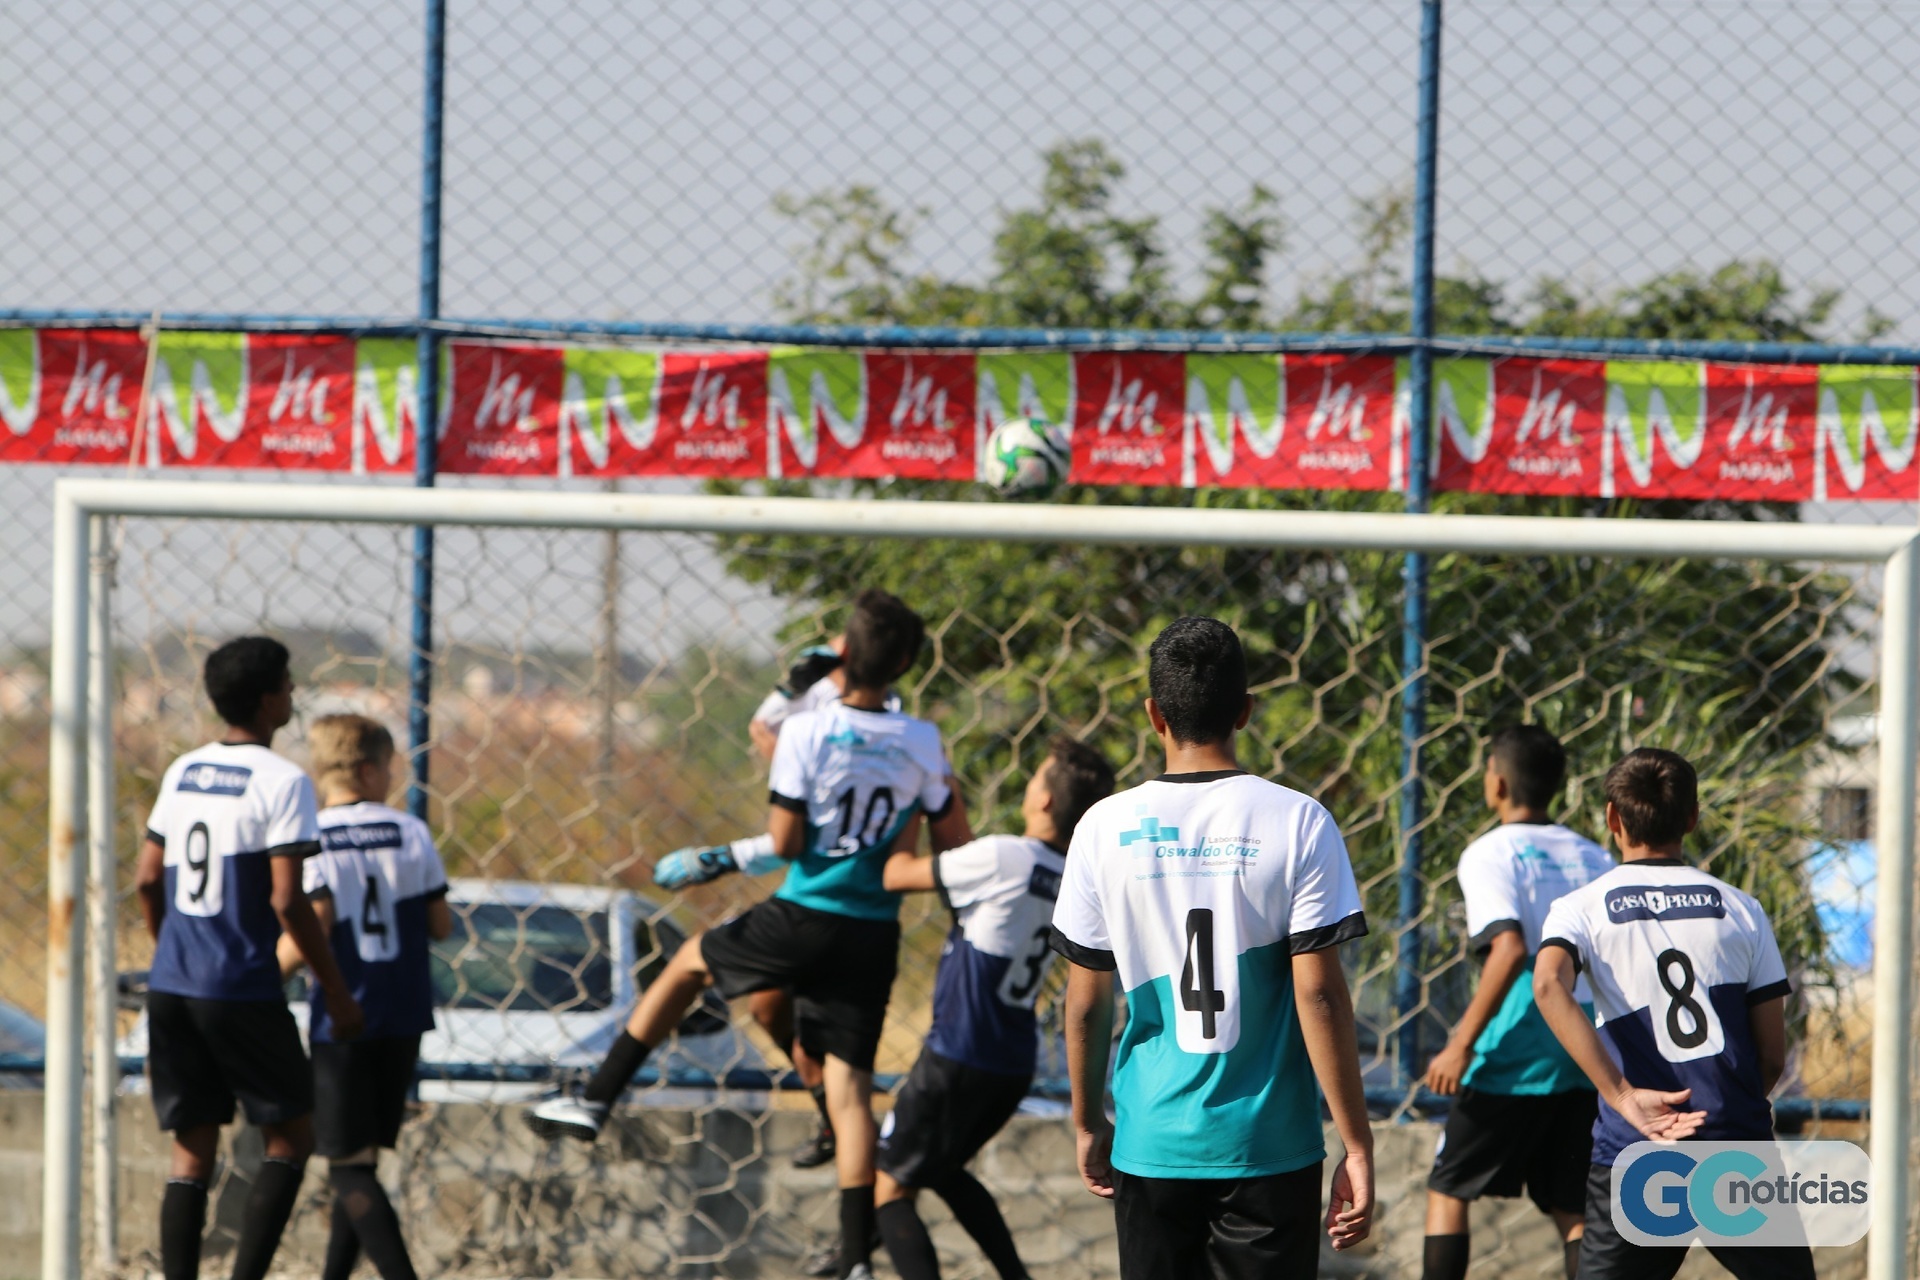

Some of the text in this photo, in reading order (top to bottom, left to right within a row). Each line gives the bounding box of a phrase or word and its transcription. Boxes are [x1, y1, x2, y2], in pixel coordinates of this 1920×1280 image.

[829, 785, 894, 852] 10
[1155, 837, 1260, 858] Oswaldo Cruz
[1208, 836, 1261, 845] Laboratório
[186, 821, 210, 903] 9
[363, 875, 388, 951] 4
[1610, 893, 1720, 914] CASA PRADO
[1010, 925, 1052, 999] 3
[1180, 908, 1225, 1040] 4
[1657, 948, 1708, 1049] 8
